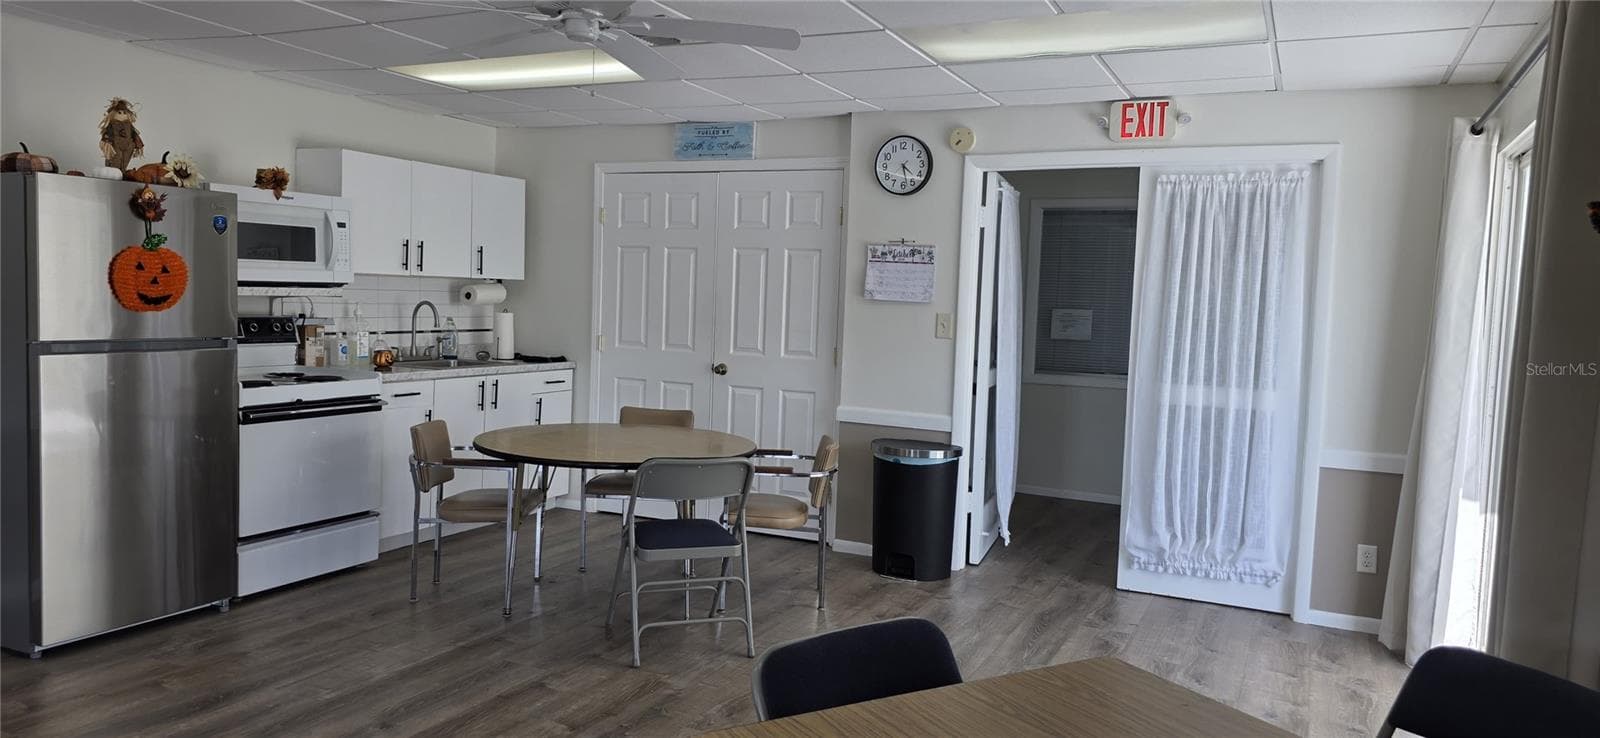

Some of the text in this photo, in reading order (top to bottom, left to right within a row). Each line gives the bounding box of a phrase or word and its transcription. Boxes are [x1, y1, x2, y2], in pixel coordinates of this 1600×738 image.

[1120, 101, 1169, 138] EXIT
[891, 144, 897, 153] 11
[899, 141, 907, 150] 12
[911, 143, 914, 151] 1
[884, 152, 891, 161] 10
[916, 149, 922, 158] 2
[881, 162, 888, 171] 9
[919, 159, 925, 168] 3
[884, 172, 890, 181] 8
[916, 170, 922, 178] 4
[891, 179, 897, 187] 7
[900, 181, 907, 190] 6
[910, 178, 916, 186] 5
